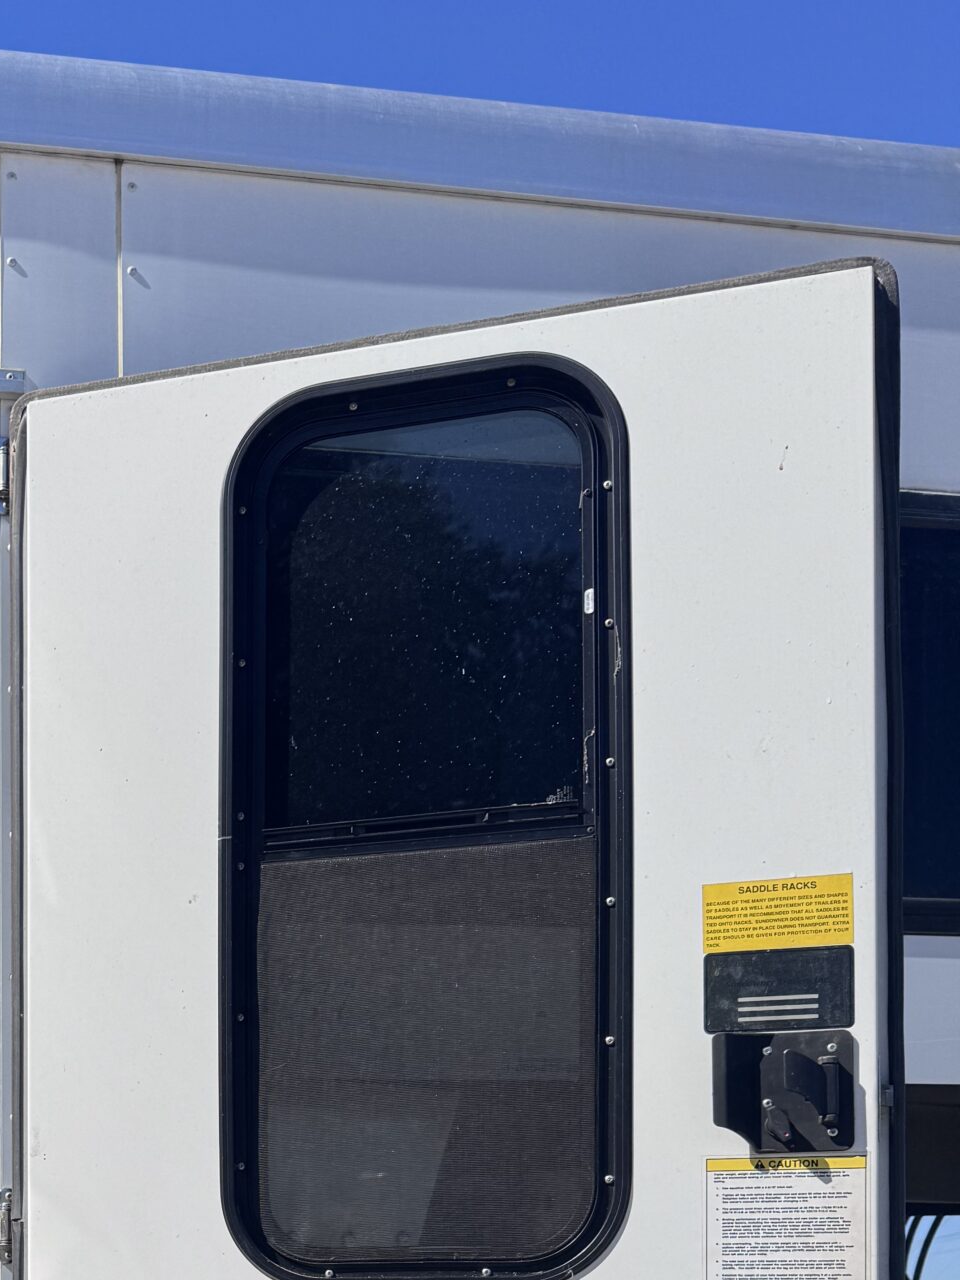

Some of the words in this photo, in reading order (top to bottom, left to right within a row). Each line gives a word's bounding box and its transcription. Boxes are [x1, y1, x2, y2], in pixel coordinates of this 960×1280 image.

[738, 884, 778, 894] SADDLE
[782, 881, 817, 891] RACKS
[768, 1160, 818, 1169] CAUTION
